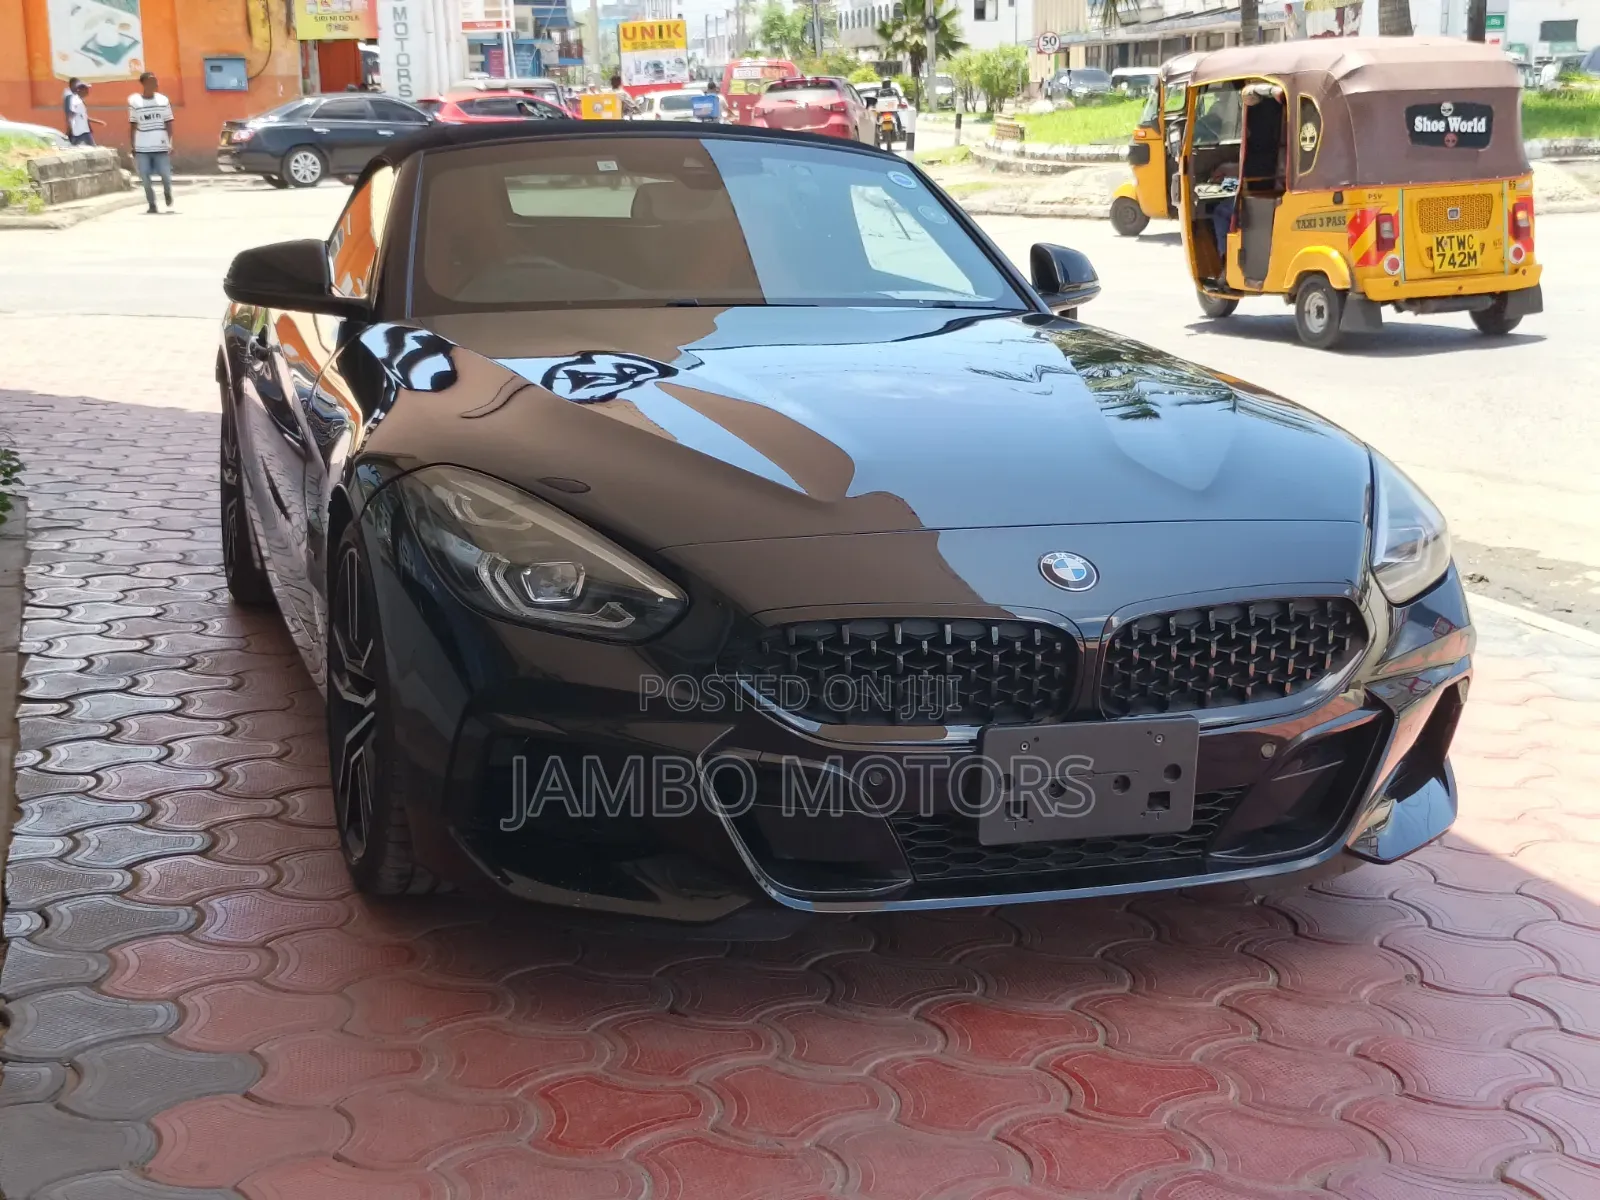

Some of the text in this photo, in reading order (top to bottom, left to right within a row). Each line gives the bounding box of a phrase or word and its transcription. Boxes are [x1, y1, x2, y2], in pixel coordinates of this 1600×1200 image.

[622, 24, 683, 40] UNIK
[1042, 35, 1057, 46] 50
[392, 6, 413, 98] MOTORS
[1414, 116, 1486, 132] Shoe World
[1296, 219, 1317, 230] TAXI
[1326, 216, 1346, 227] PASS
[1437, 250, 1477, 269] 742M
